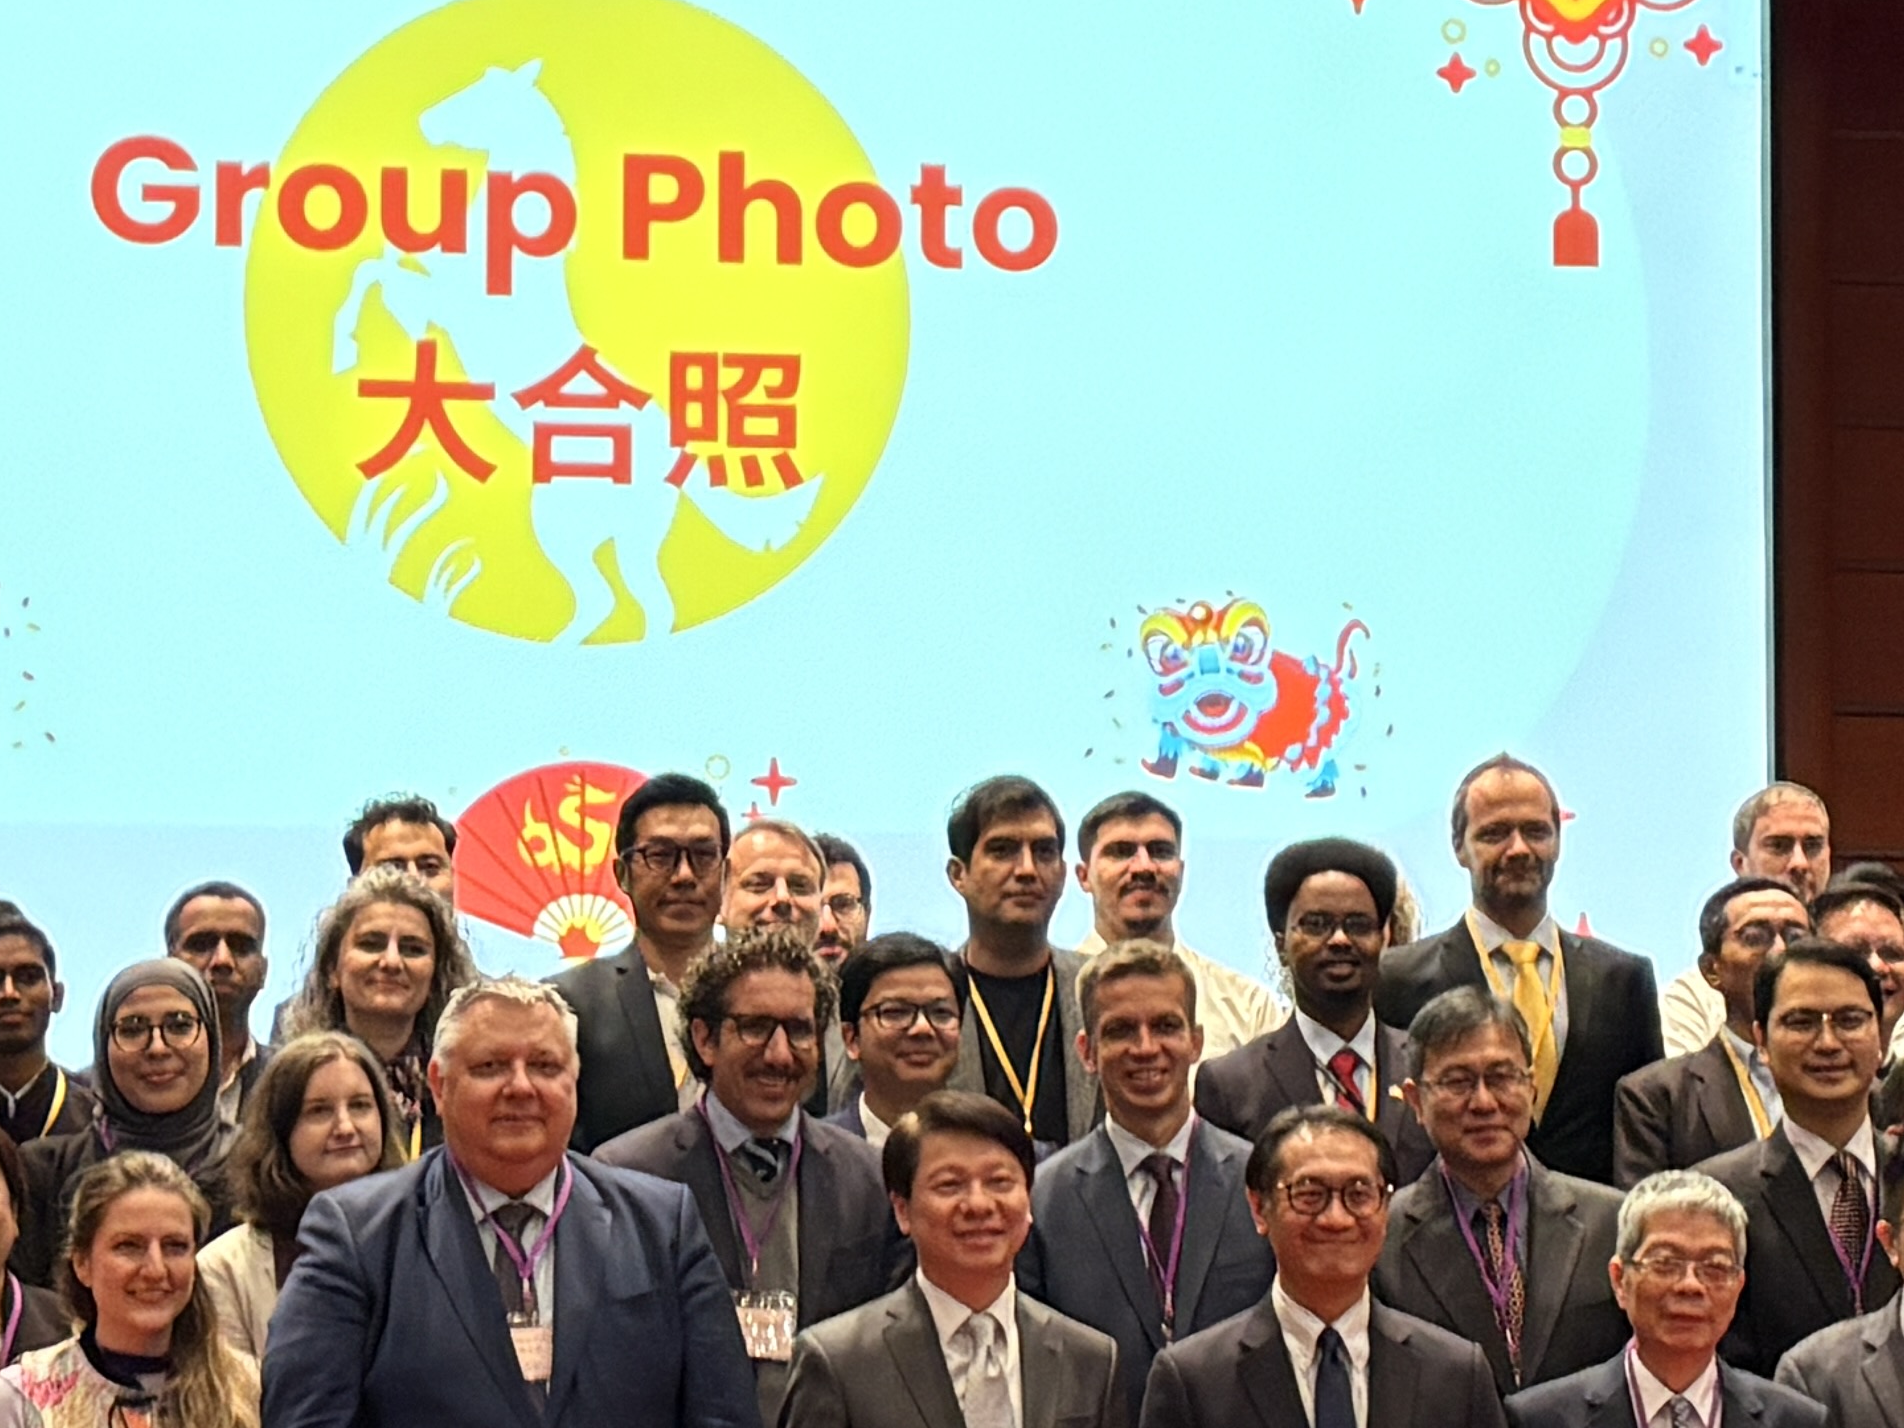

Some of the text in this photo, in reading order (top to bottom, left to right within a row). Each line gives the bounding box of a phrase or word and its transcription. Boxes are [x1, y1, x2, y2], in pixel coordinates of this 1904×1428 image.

[90, 134, 1058, 296] Group Photo
[356, 339, 804, 488] 大合照
